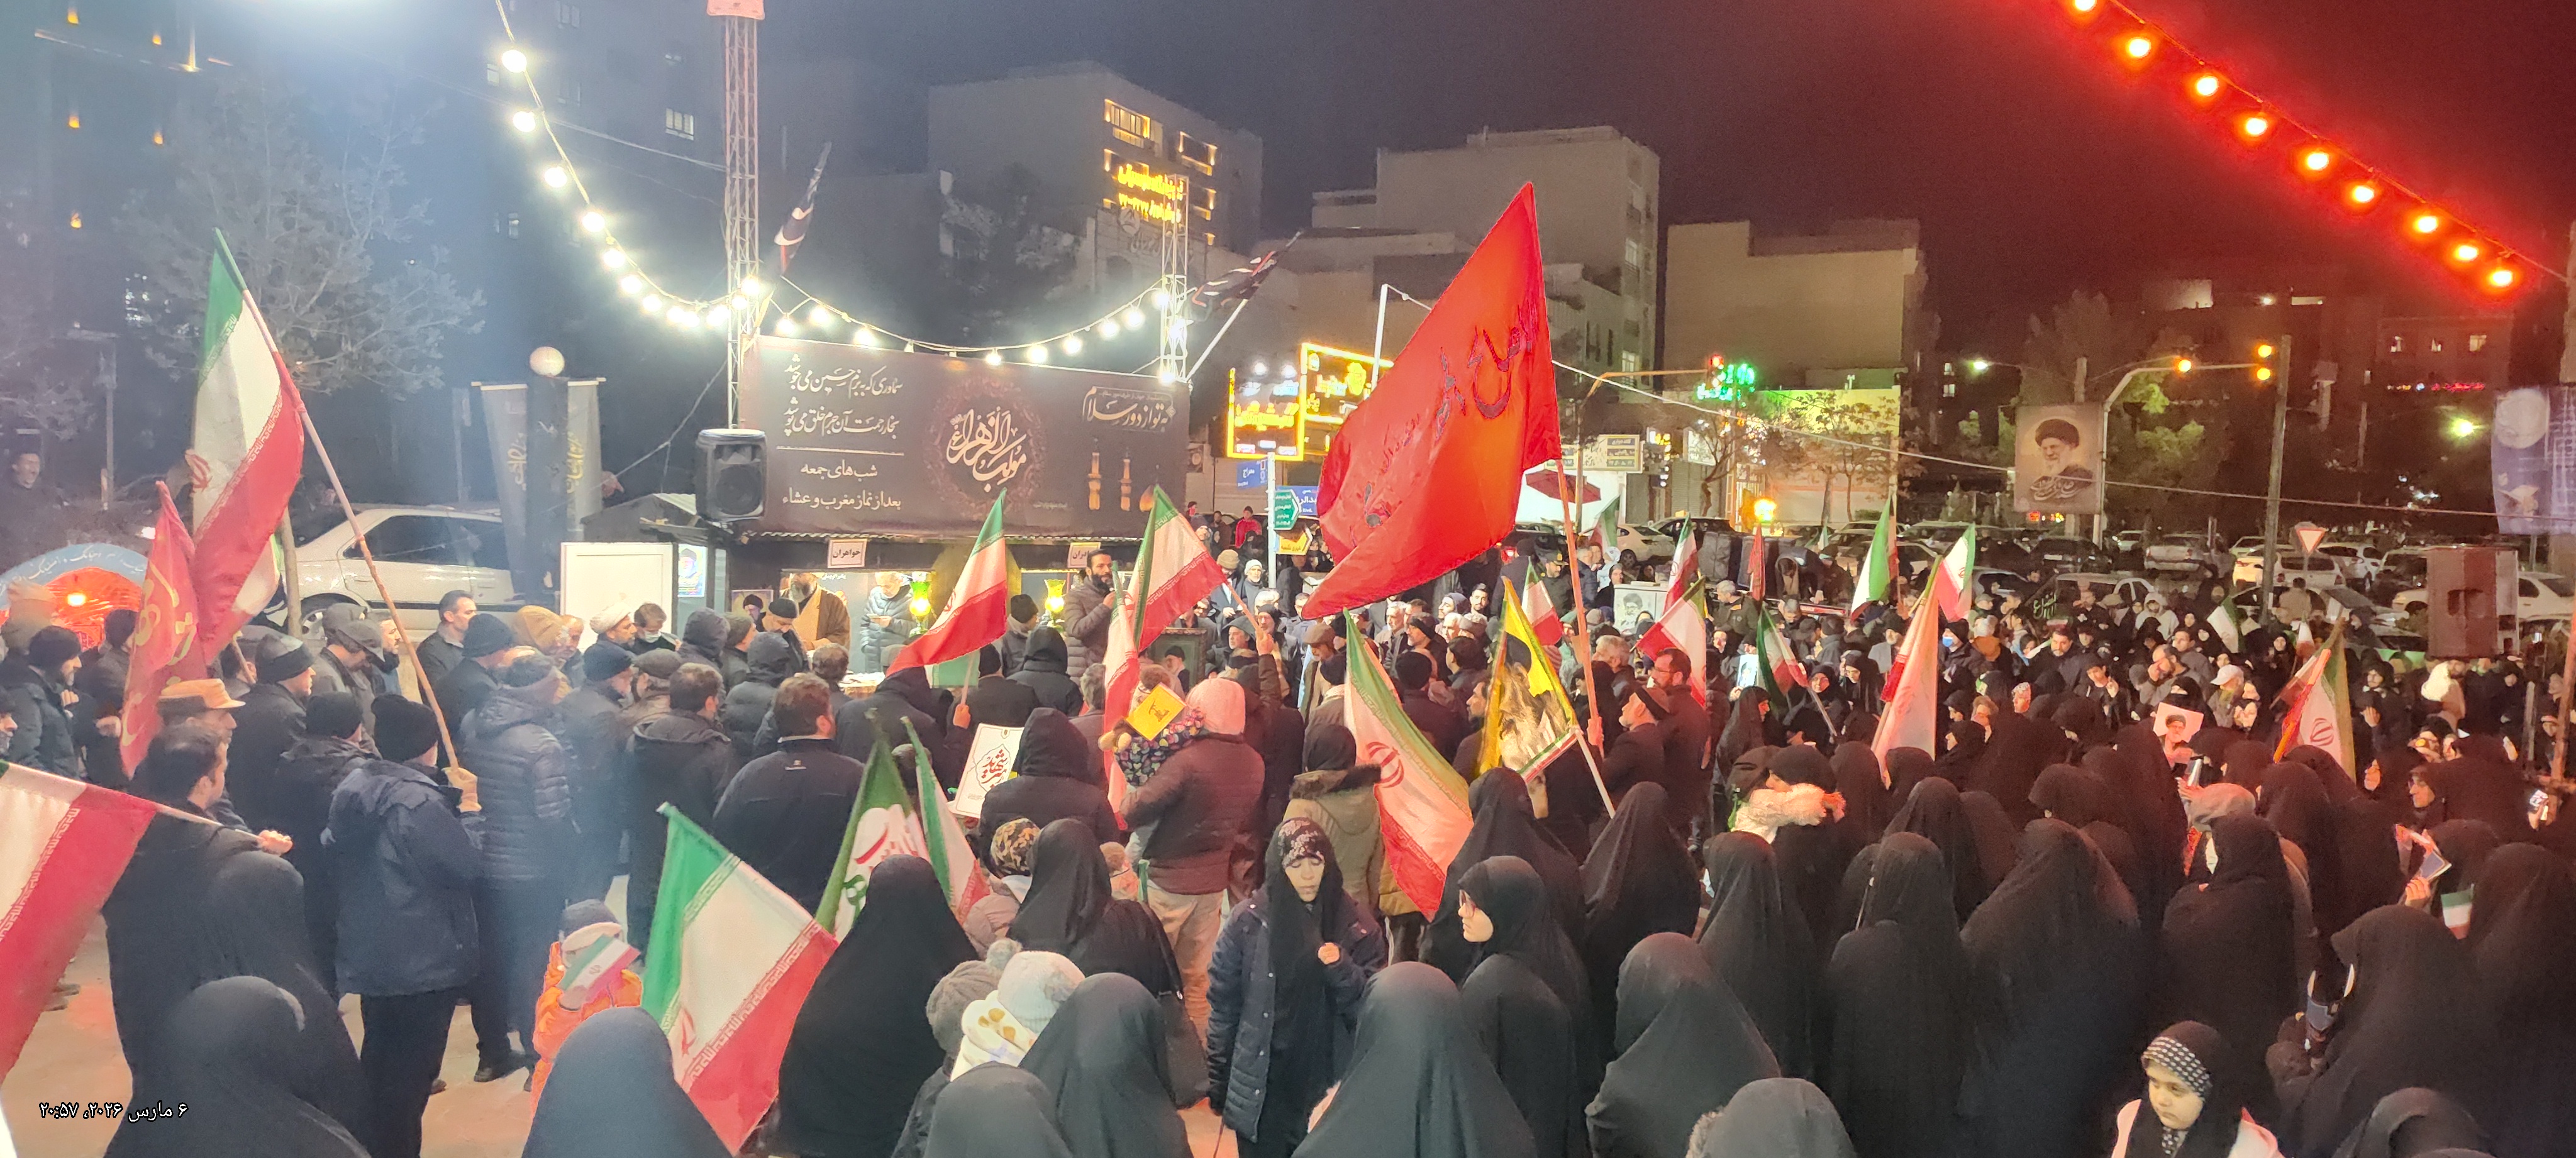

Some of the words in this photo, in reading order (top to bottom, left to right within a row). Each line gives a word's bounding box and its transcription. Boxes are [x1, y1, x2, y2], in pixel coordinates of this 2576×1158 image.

[810, 368, 857, 396] حسین
[865, 365, 887, 390] که
[1082, 386, 1138, 422] سلام
[804, 406, 826, 433] خلق
[801, 464, 828, 480] جمعه
[973, 434, 1026, 492] موکب
[810, 496, 820, 508] و
[820, 494, 855, 510] مغرب
[854, 490, 873, 509] نماز
[871, 491, 884, 510] از
[883, 497, 901, 510] بعد
[833, 549, 861, 558] خواهران
